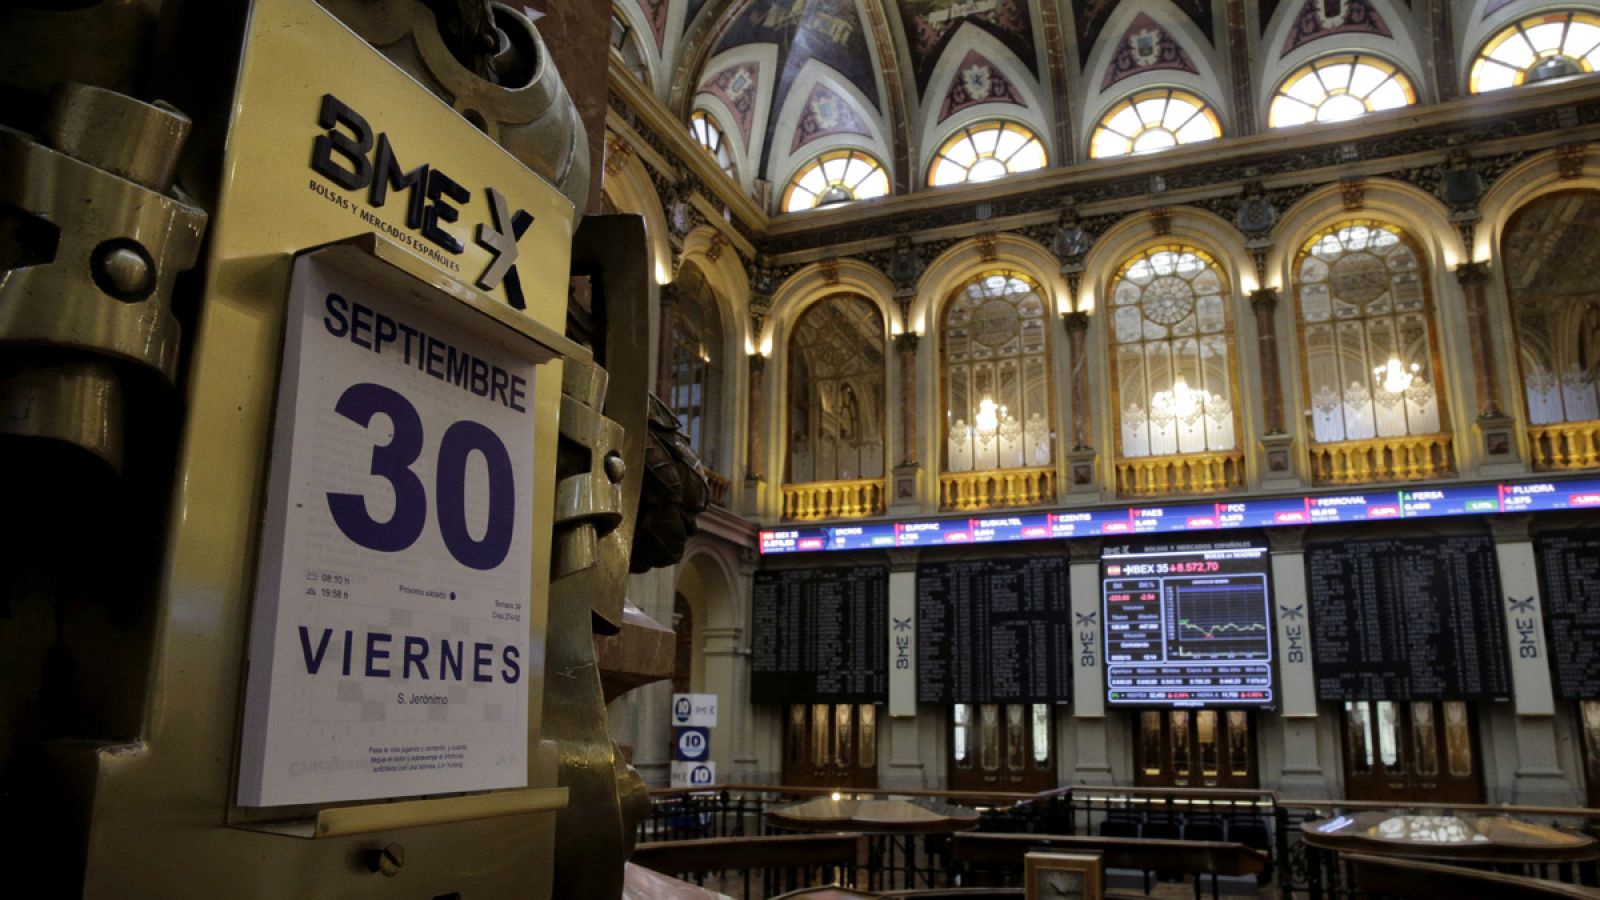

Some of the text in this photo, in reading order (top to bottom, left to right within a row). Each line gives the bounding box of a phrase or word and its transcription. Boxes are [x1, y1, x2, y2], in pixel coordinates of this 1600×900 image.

[309, 179, 461, 272] BOLSAS Y MERCADOS ESPAÑOLES
[323, 292, 526, 413] SEPTIEMBRE
[326, 383, 515, 570] 30
[1227, 503, 1246, 512] FCC
[1155, 563, 1169, 573] 35
[298, 626, 521, 684] VIERNES
[409, 693, 448, 705] Jerónimo
[685, 735, 701, 747] 10
